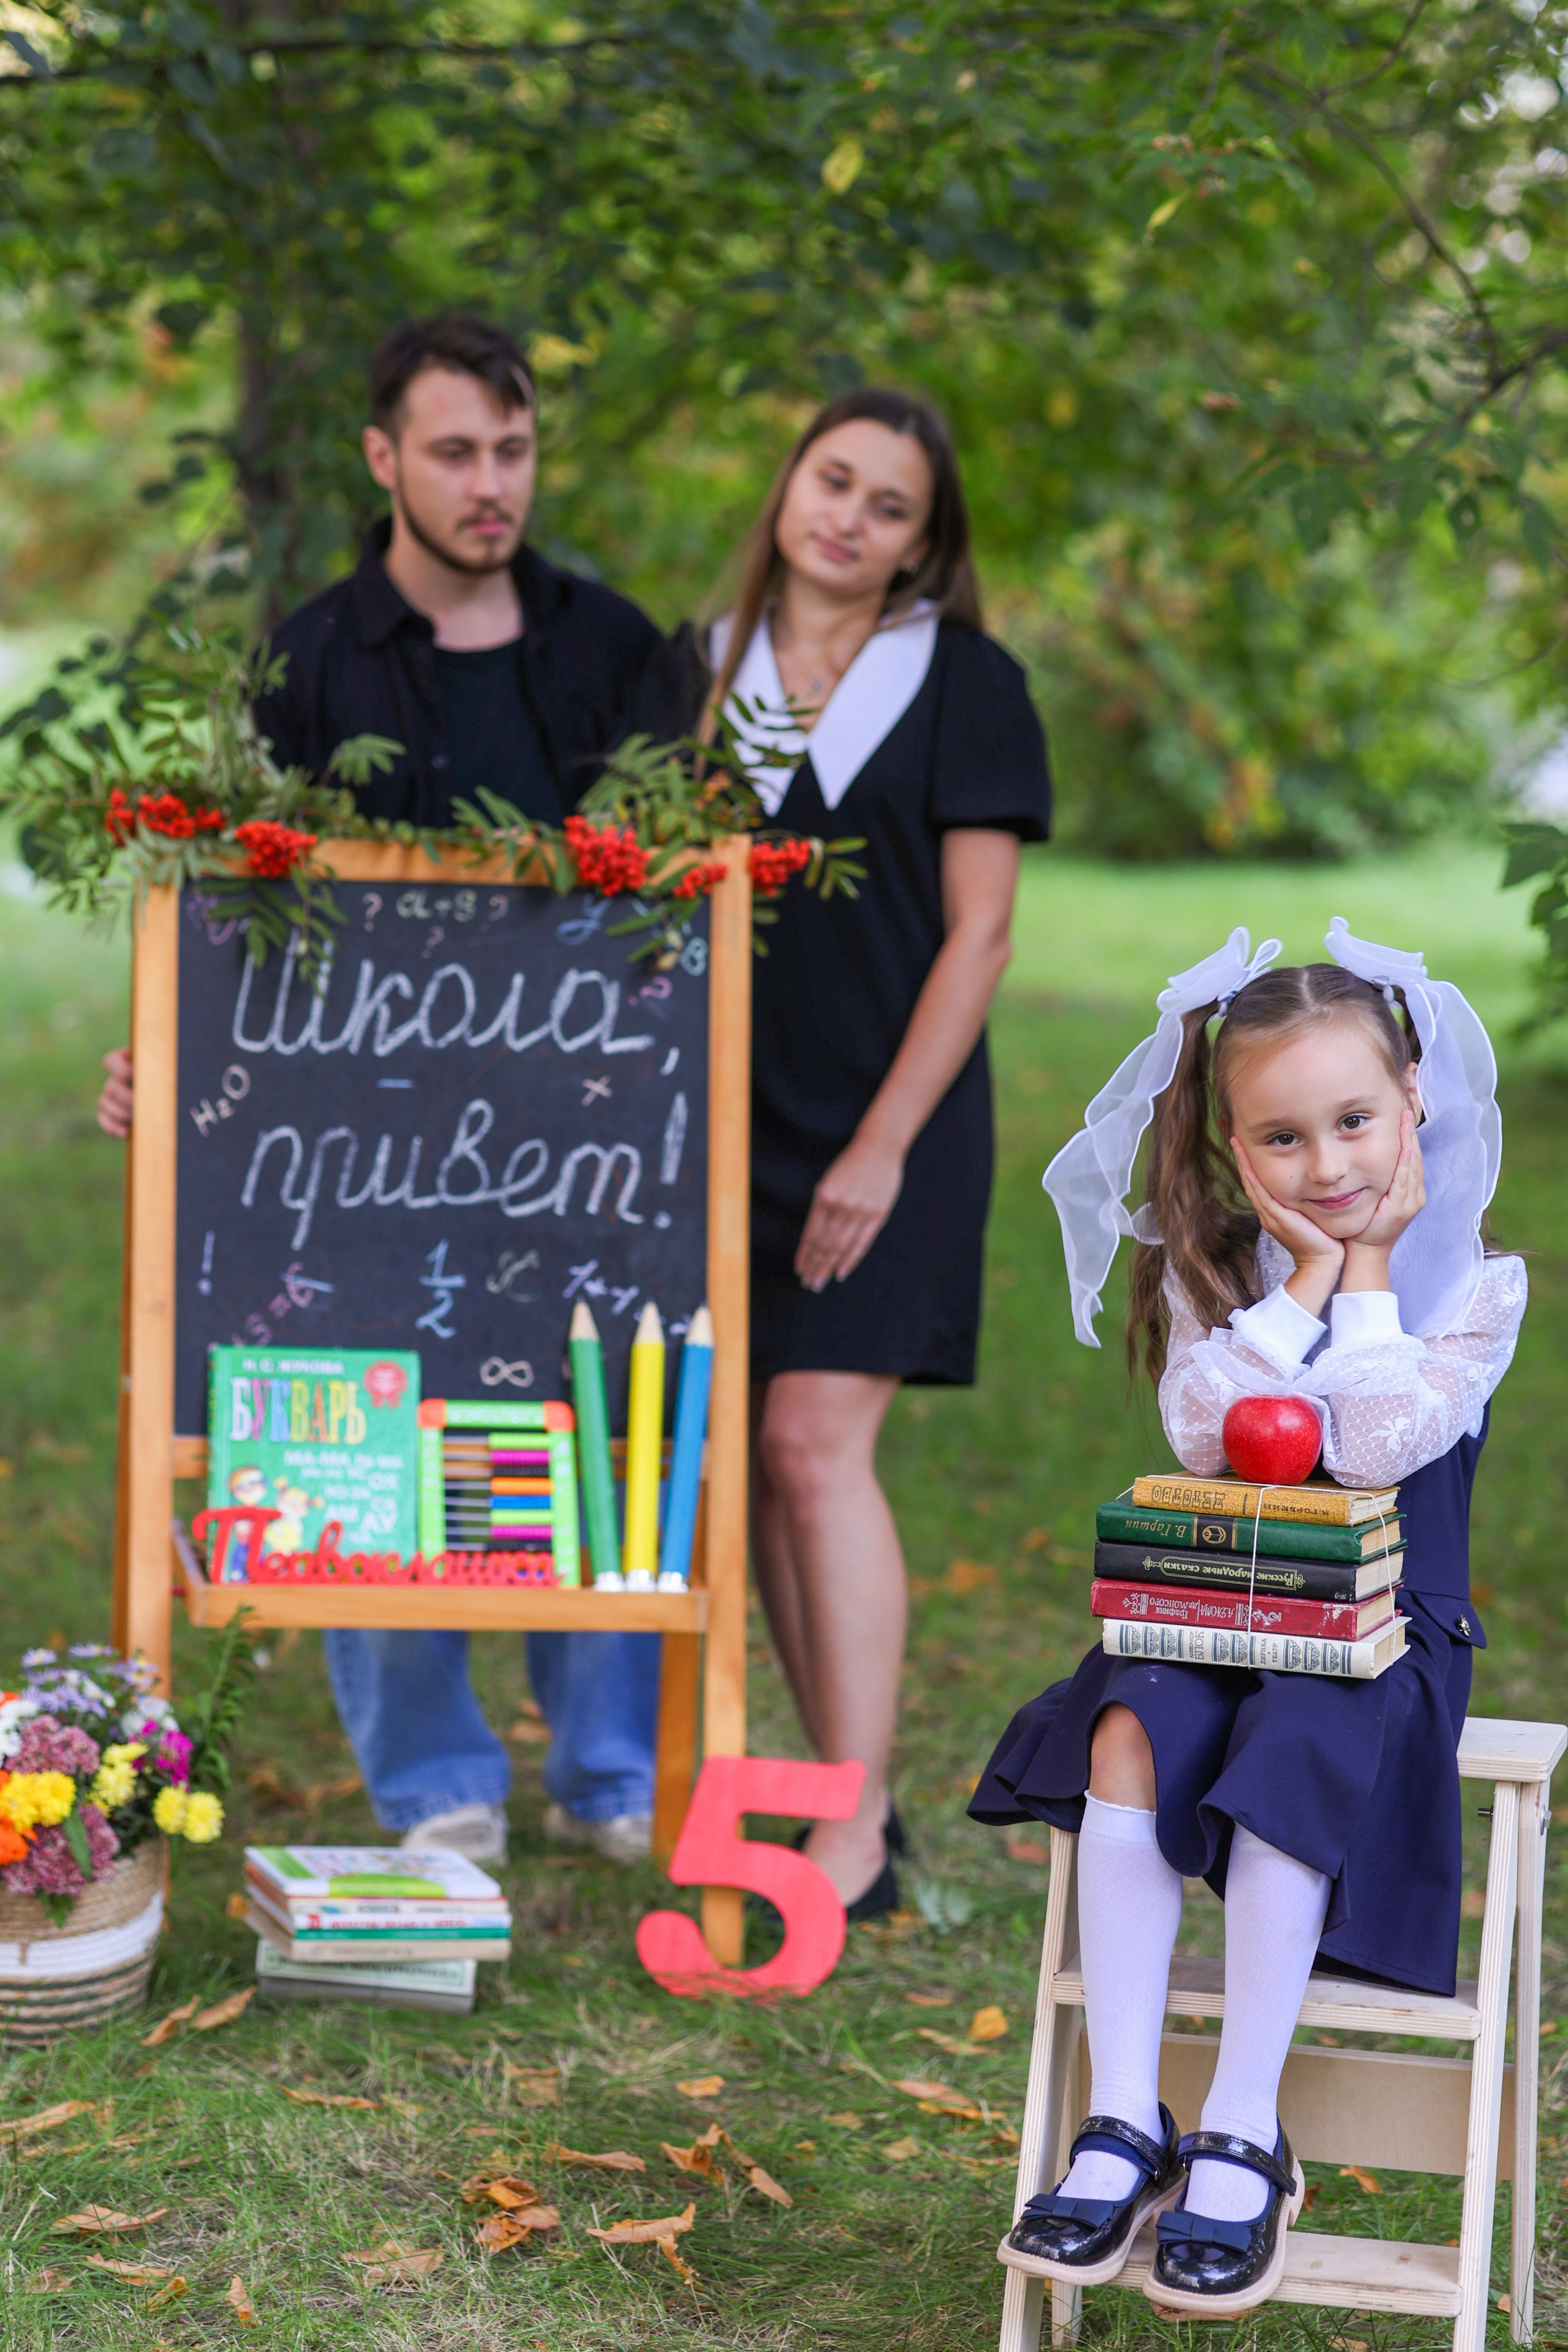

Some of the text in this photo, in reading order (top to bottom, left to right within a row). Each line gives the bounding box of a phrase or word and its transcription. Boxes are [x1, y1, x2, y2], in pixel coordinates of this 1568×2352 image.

[232, 928, 680, 1076] Школа,
[241, 1091, 688, 1251] привет!
[230, 1376, 367, 1446] БУКВАРЬ
[1150, 1485, 1226, 1510] ДЕТСТВО
[1125, 1518, 1187, 1538] В. Гаршин
[1164, 1562, 1294, 1587] Русские народные сказки
[1155, 1607, 1189, 1619] Графиня
[1194, 1630, 1205, 1661] БЛОК
[635, 1755, 867, 2002] 5
